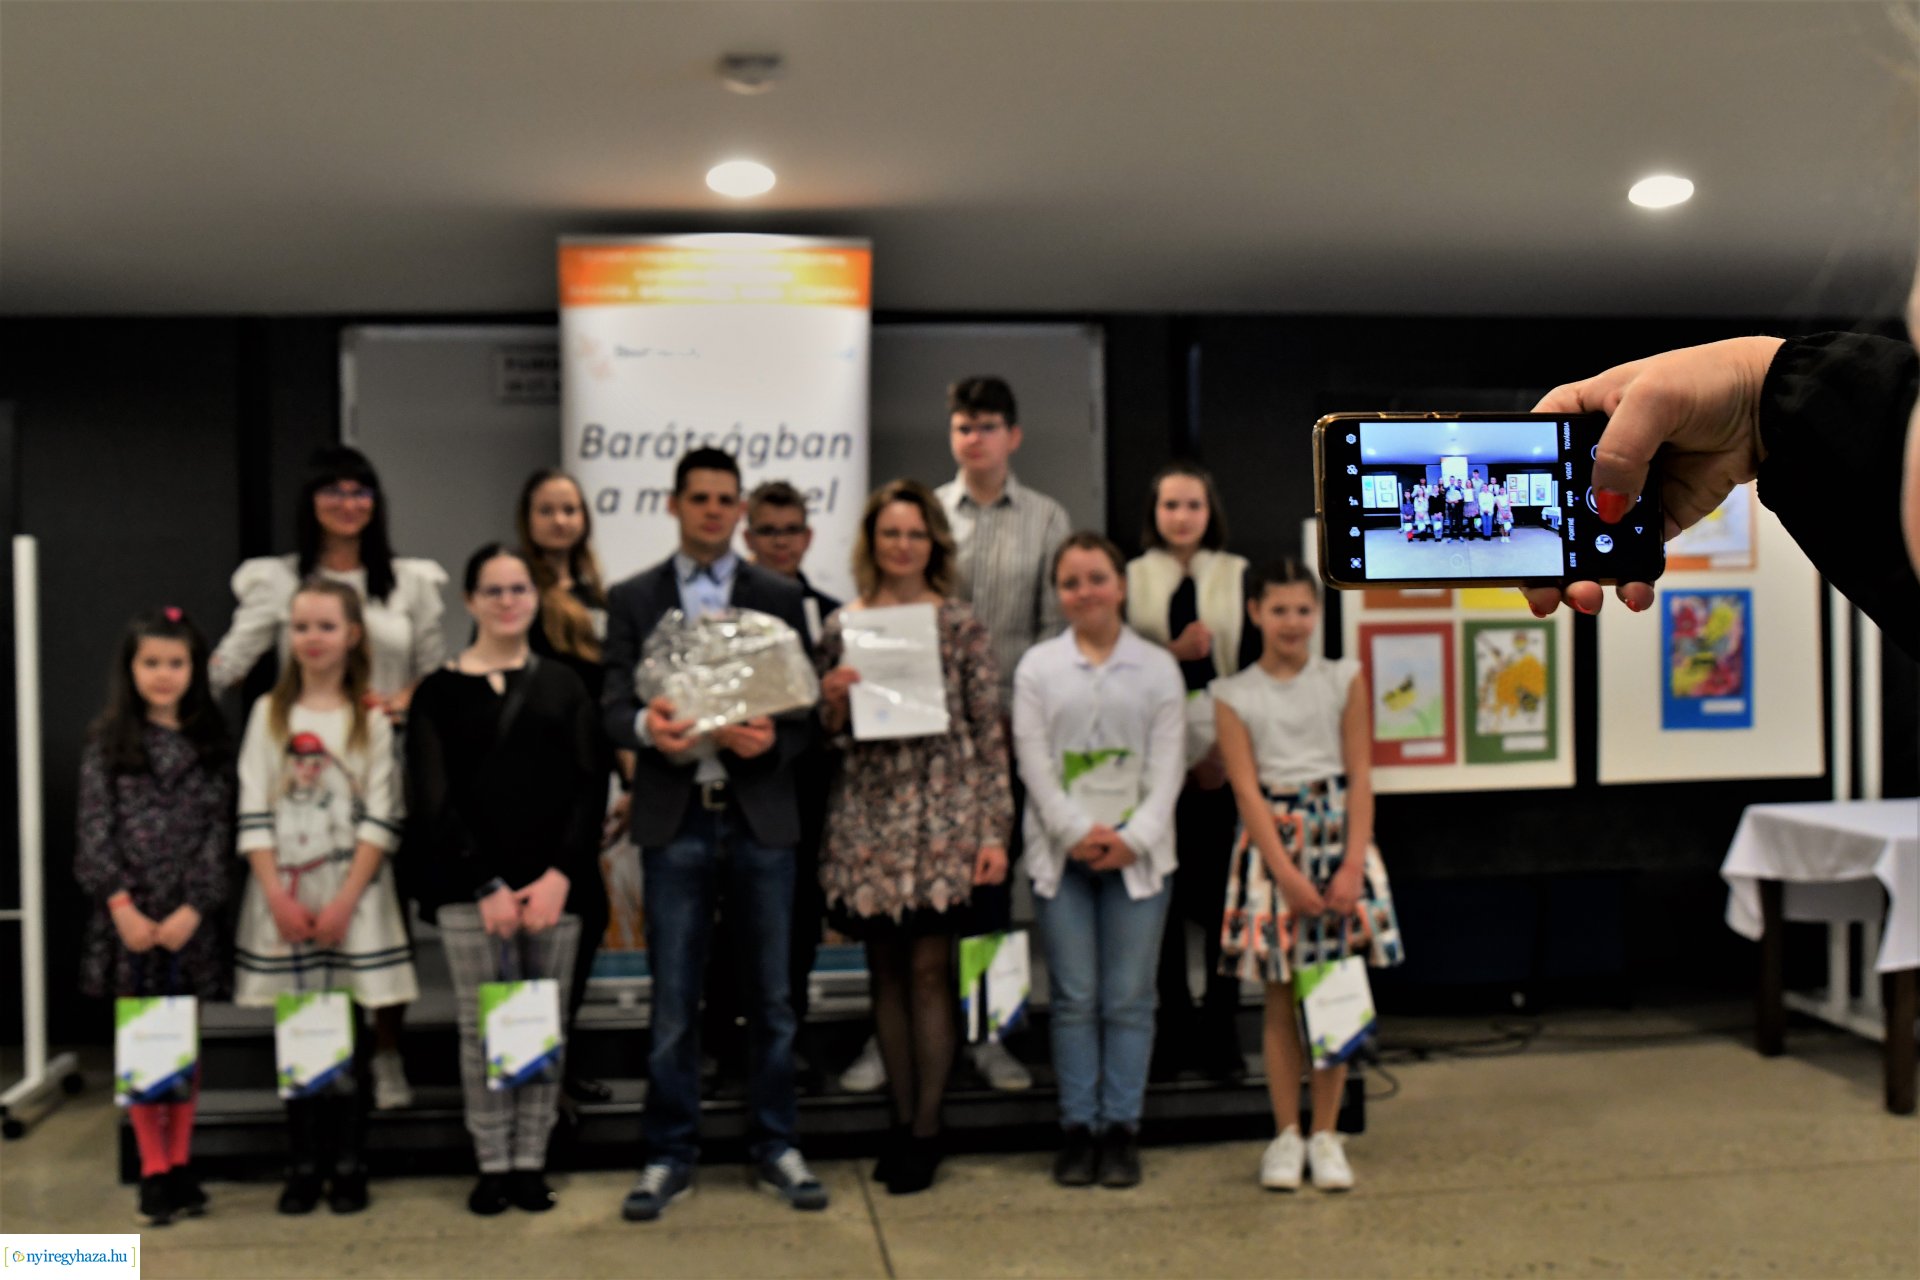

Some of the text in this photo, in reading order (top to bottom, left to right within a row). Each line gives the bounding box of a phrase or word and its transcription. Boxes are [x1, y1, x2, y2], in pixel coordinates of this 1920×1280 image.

[596, 486, 621, 515] a
[1566, 491, 1574, 507] FOTÓ
[1567, 518, 1575, 540] PORTRÉ
